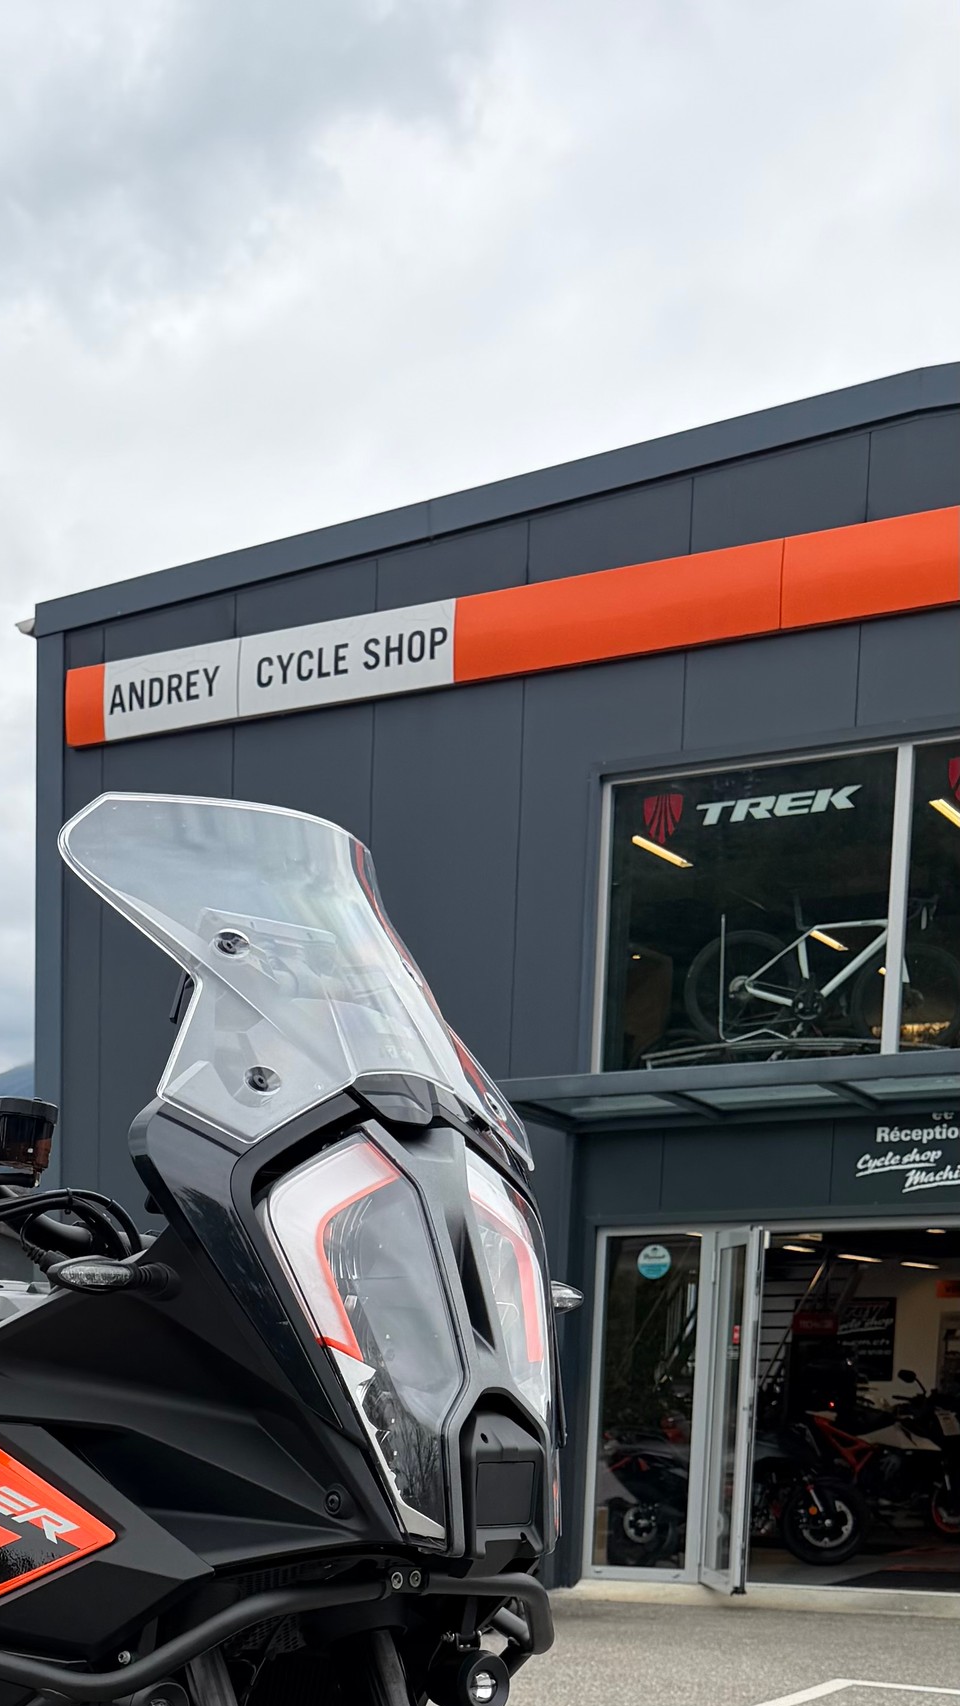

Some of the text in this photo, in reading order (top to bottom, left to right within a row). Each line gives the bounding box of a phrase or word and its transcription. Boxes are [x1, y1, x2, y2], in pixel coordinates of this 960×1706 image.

[109, 626, 449, 716] ANDREY CYCLE SHOP
[696, 784, 863, 826] TREK
[876, 1123, 960, 1144] Réceptio
